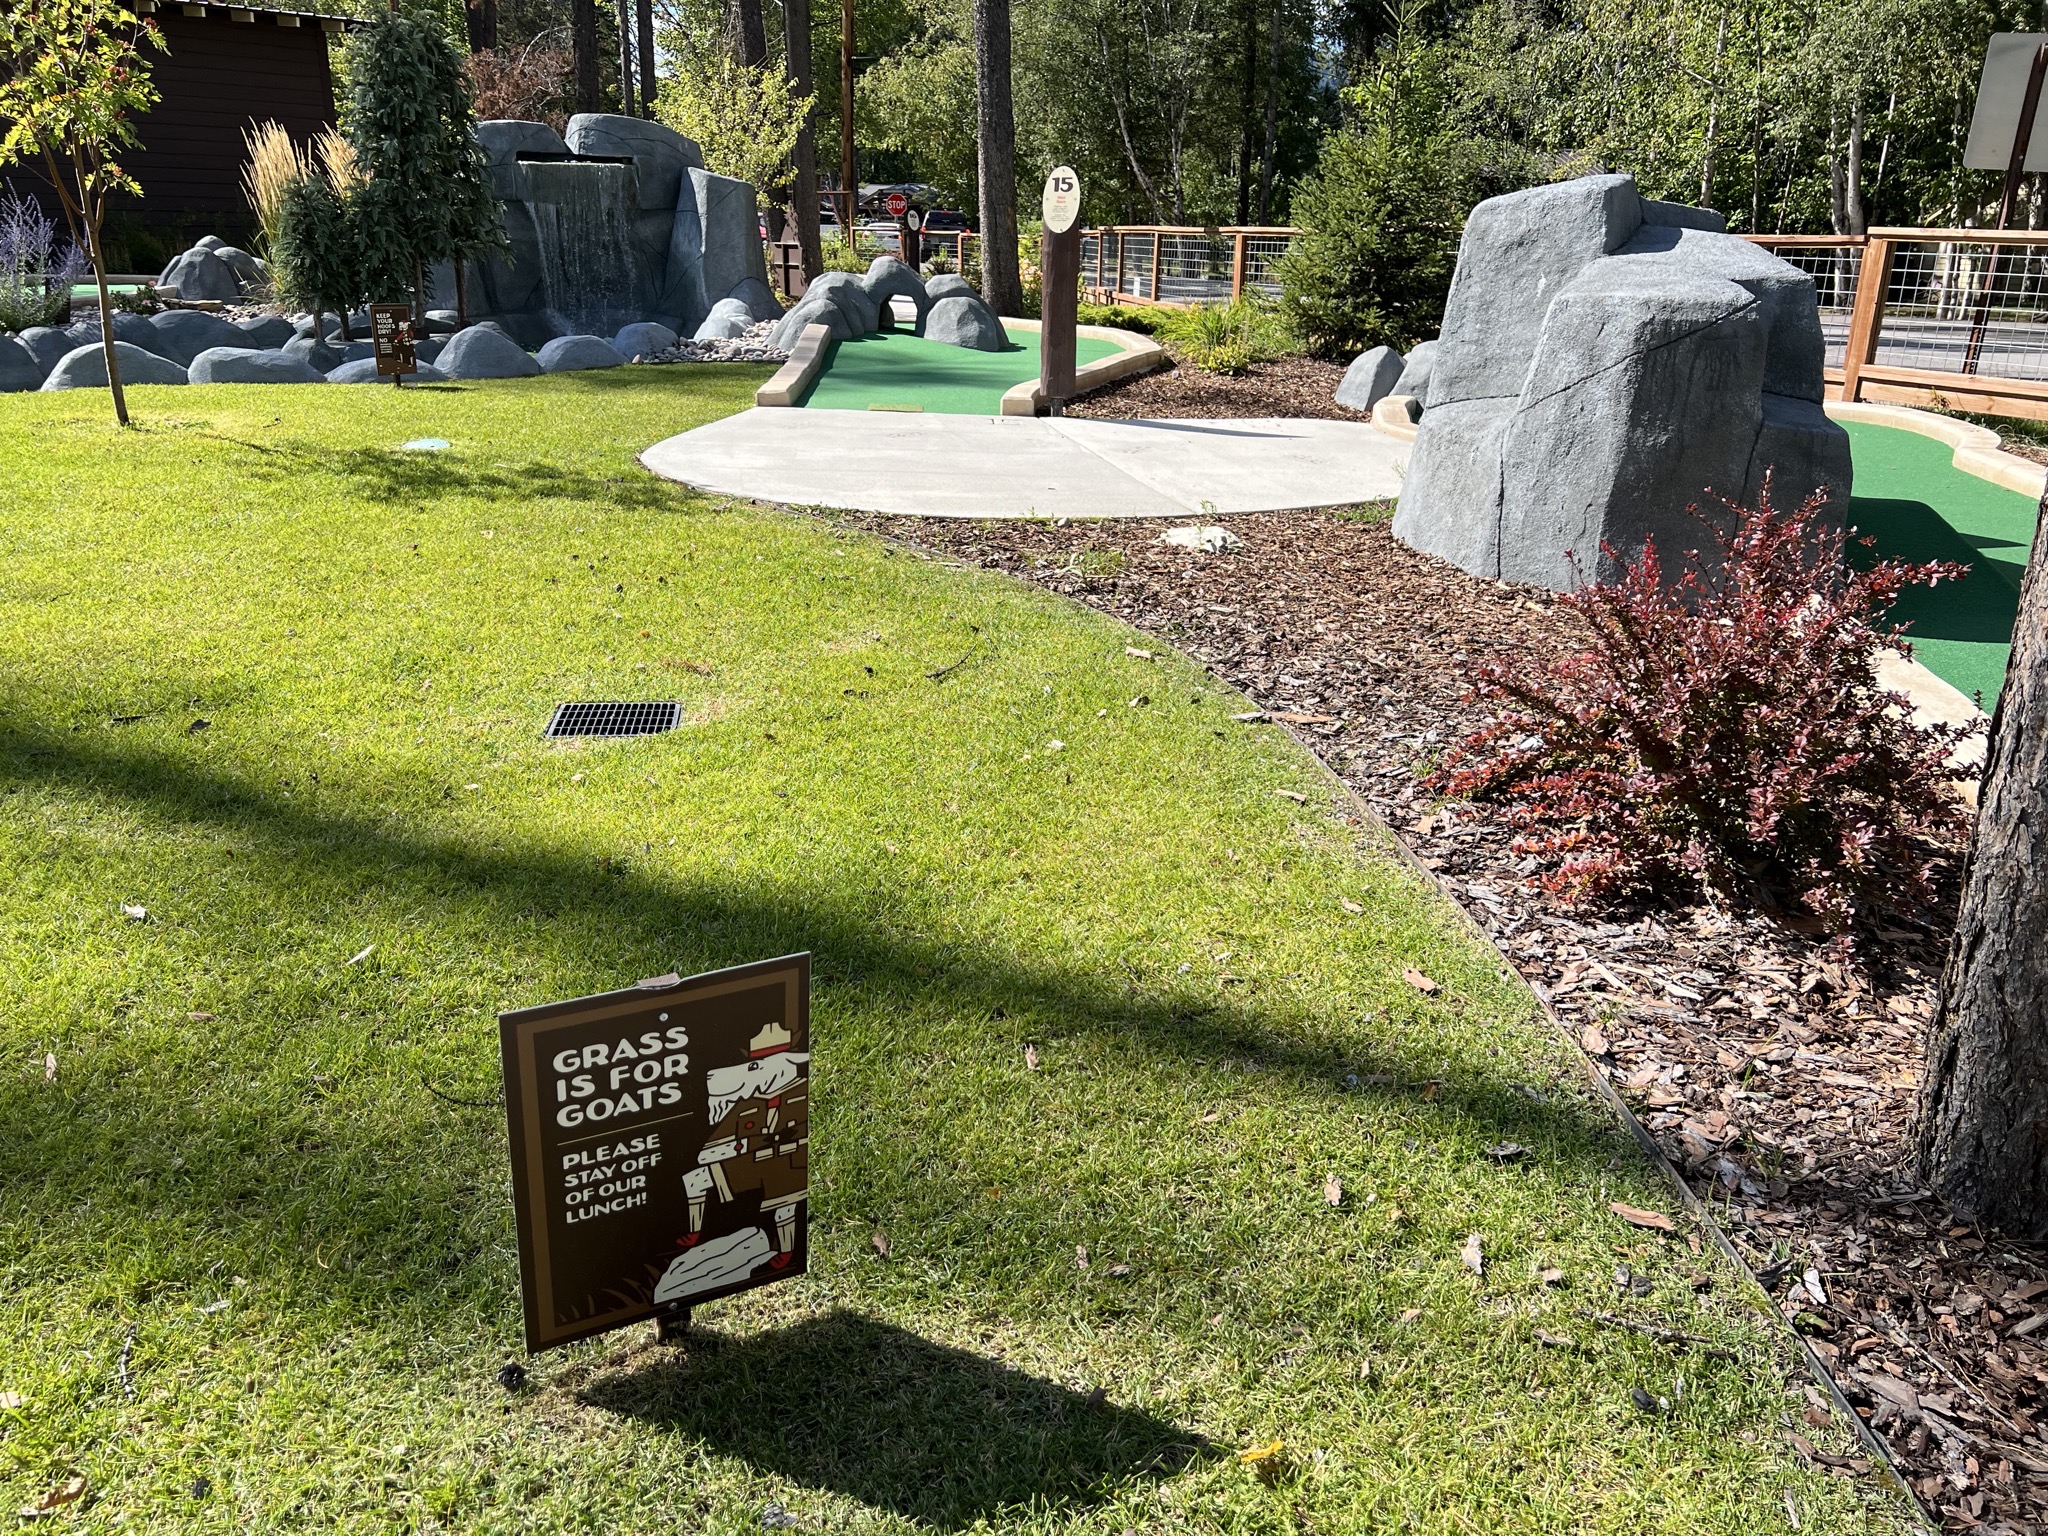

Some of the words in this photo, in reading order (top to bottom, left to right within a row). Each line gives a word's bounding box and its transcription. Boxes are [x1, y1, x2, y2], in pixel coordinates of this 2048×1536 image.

[1052, 177, 1073, 192] 15
[888, 200, 905, 209] STOP
[553, 1026, 689, 1073] GRASS
[556, 1074, 596, 1102] IS
[609, 1053, 689, 1090] FOR
[556, 1082, 682, 1127] GOATS
[562, 1133, 661, 1170] PLEASE
[564, 1163, 617, 1187] STAY
[621, 1152, 662, 1173] OFF
[565, 1187, 595, 1205] OF
[598, 1175, 646, 1197] OUR
[566, 1191, 648, 1224] LUNCH!
